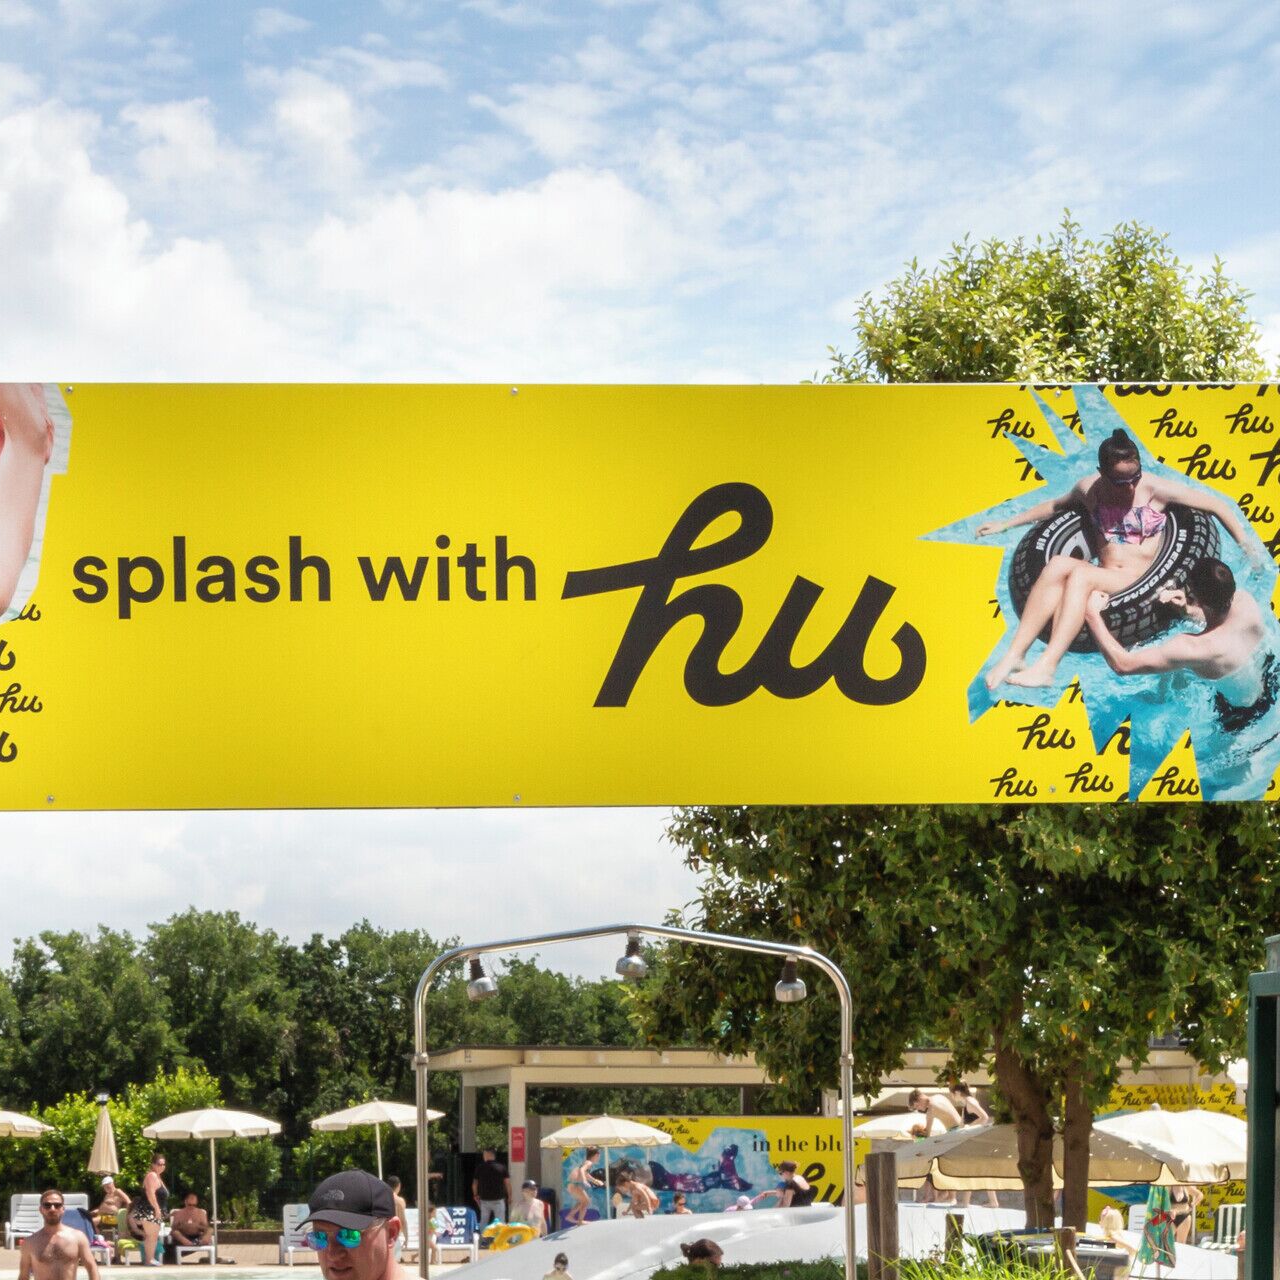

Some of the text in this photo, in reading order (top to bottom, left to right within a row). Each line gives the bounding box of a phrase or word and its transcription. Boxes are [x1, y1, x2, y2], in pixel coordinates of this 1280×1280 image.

[987, 409, 1036, 439] hu
[1149, 408, 1198, 438] hu
[1225, 403, 1274, 434] hu
[1177, 444, 1237, 481] hu
[73, 481, 927, 708] splash with hu
[1017, 713, 1076, 750] hu
[989, 767, 1038, 797] hu
[1064, 762, 1114, 793] hu
[1151, 766, 1200, 796] hu
[753, 1134, 770, 1152] in
[777, 1135, 809, 1152] the
